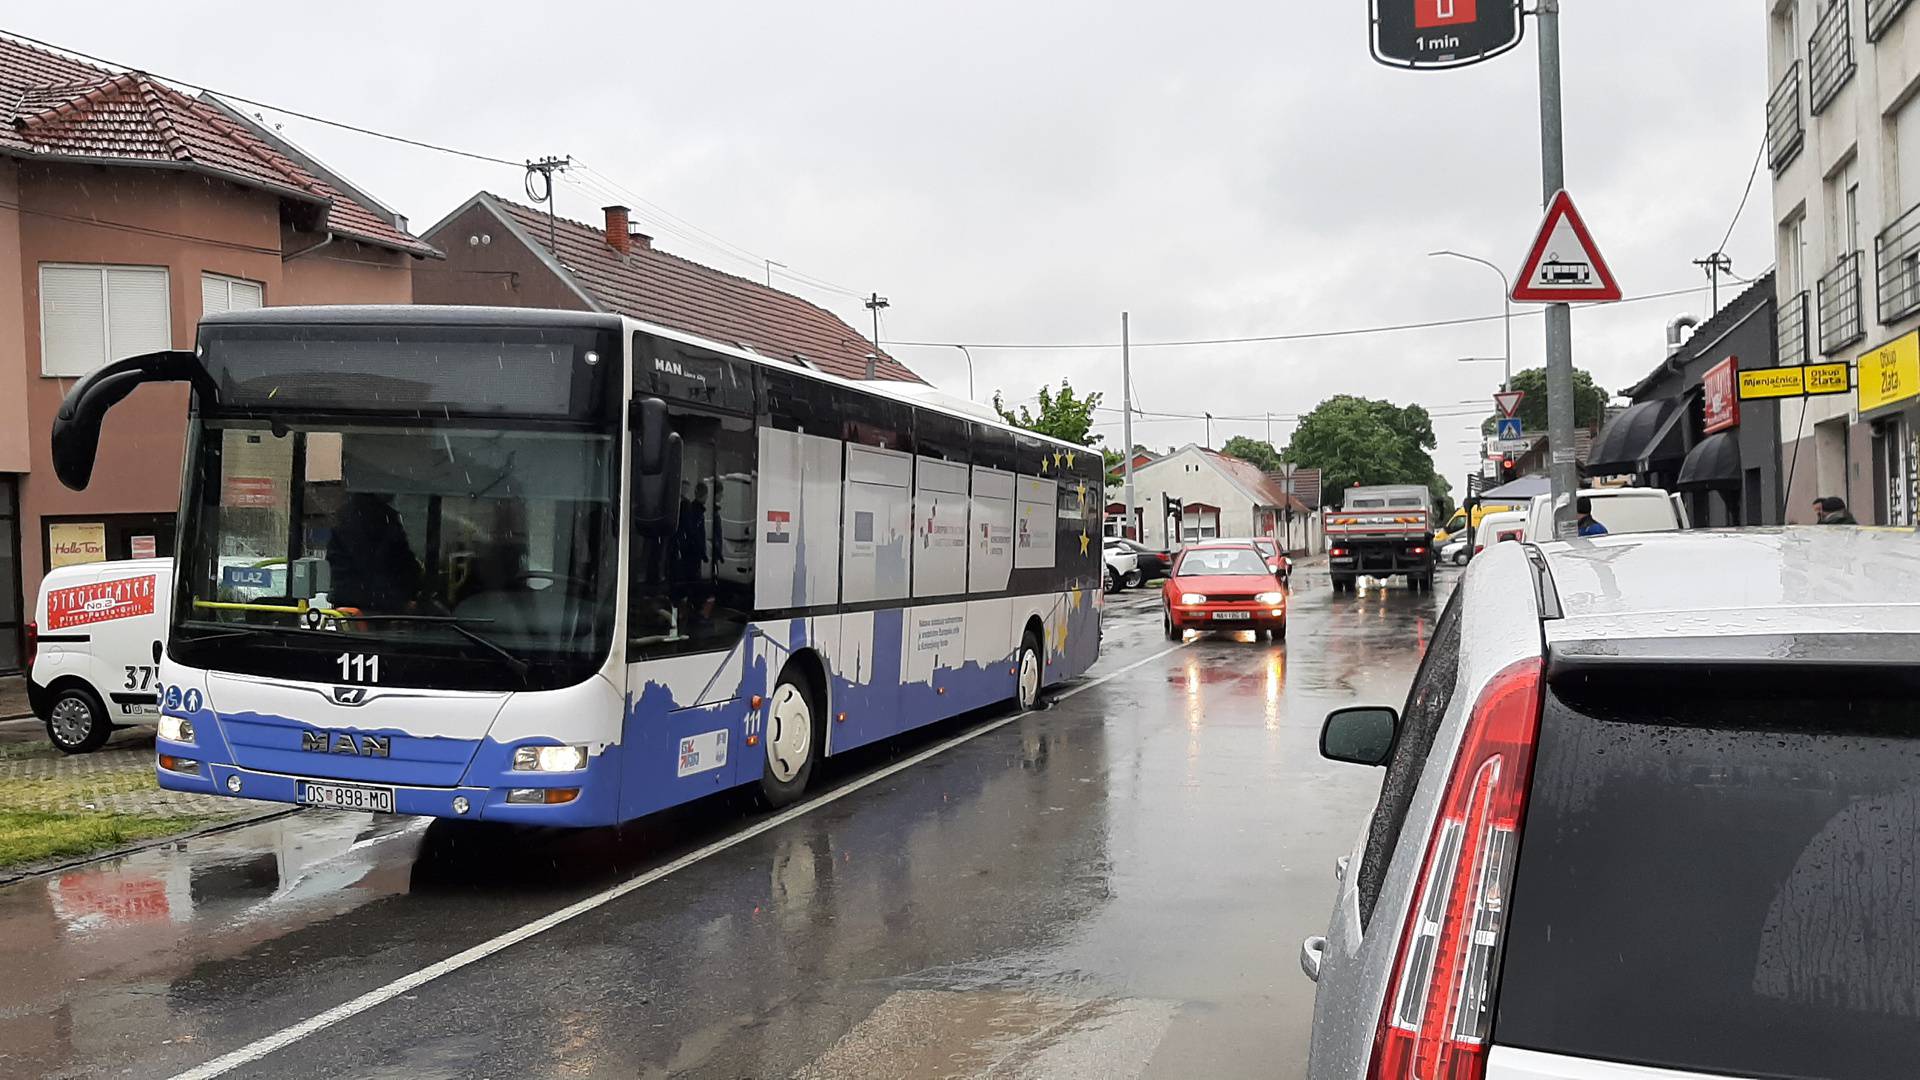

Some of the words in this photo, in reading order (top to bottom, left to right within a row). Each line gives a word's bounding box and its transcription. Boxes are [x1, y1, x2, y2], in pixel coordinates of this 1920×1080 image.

[1416, 36, 1424, 51] 1
[1429, 34, 1459, 49] min
[655, 358, 682, 376] MAN
[1880, 349, 1897, 369] Otkup
[1810, 377, 1841, 386] Zlata
[1811, 369, 1840, 378] Otkup
[1881, 369, 1899, 394] Zlata
[55, 541, 81, 554] Hallo
[231, 571, 263, 584] ULAZ
[86, 599, 113, 611] No.2
[337, 652, 379, 683] 111
[743, 710, 761, 736] 111
[302, 731, 390, 758] MAN
[307, 785, 324, 803] OS
[335, 787, 389, 809] 898-MO
